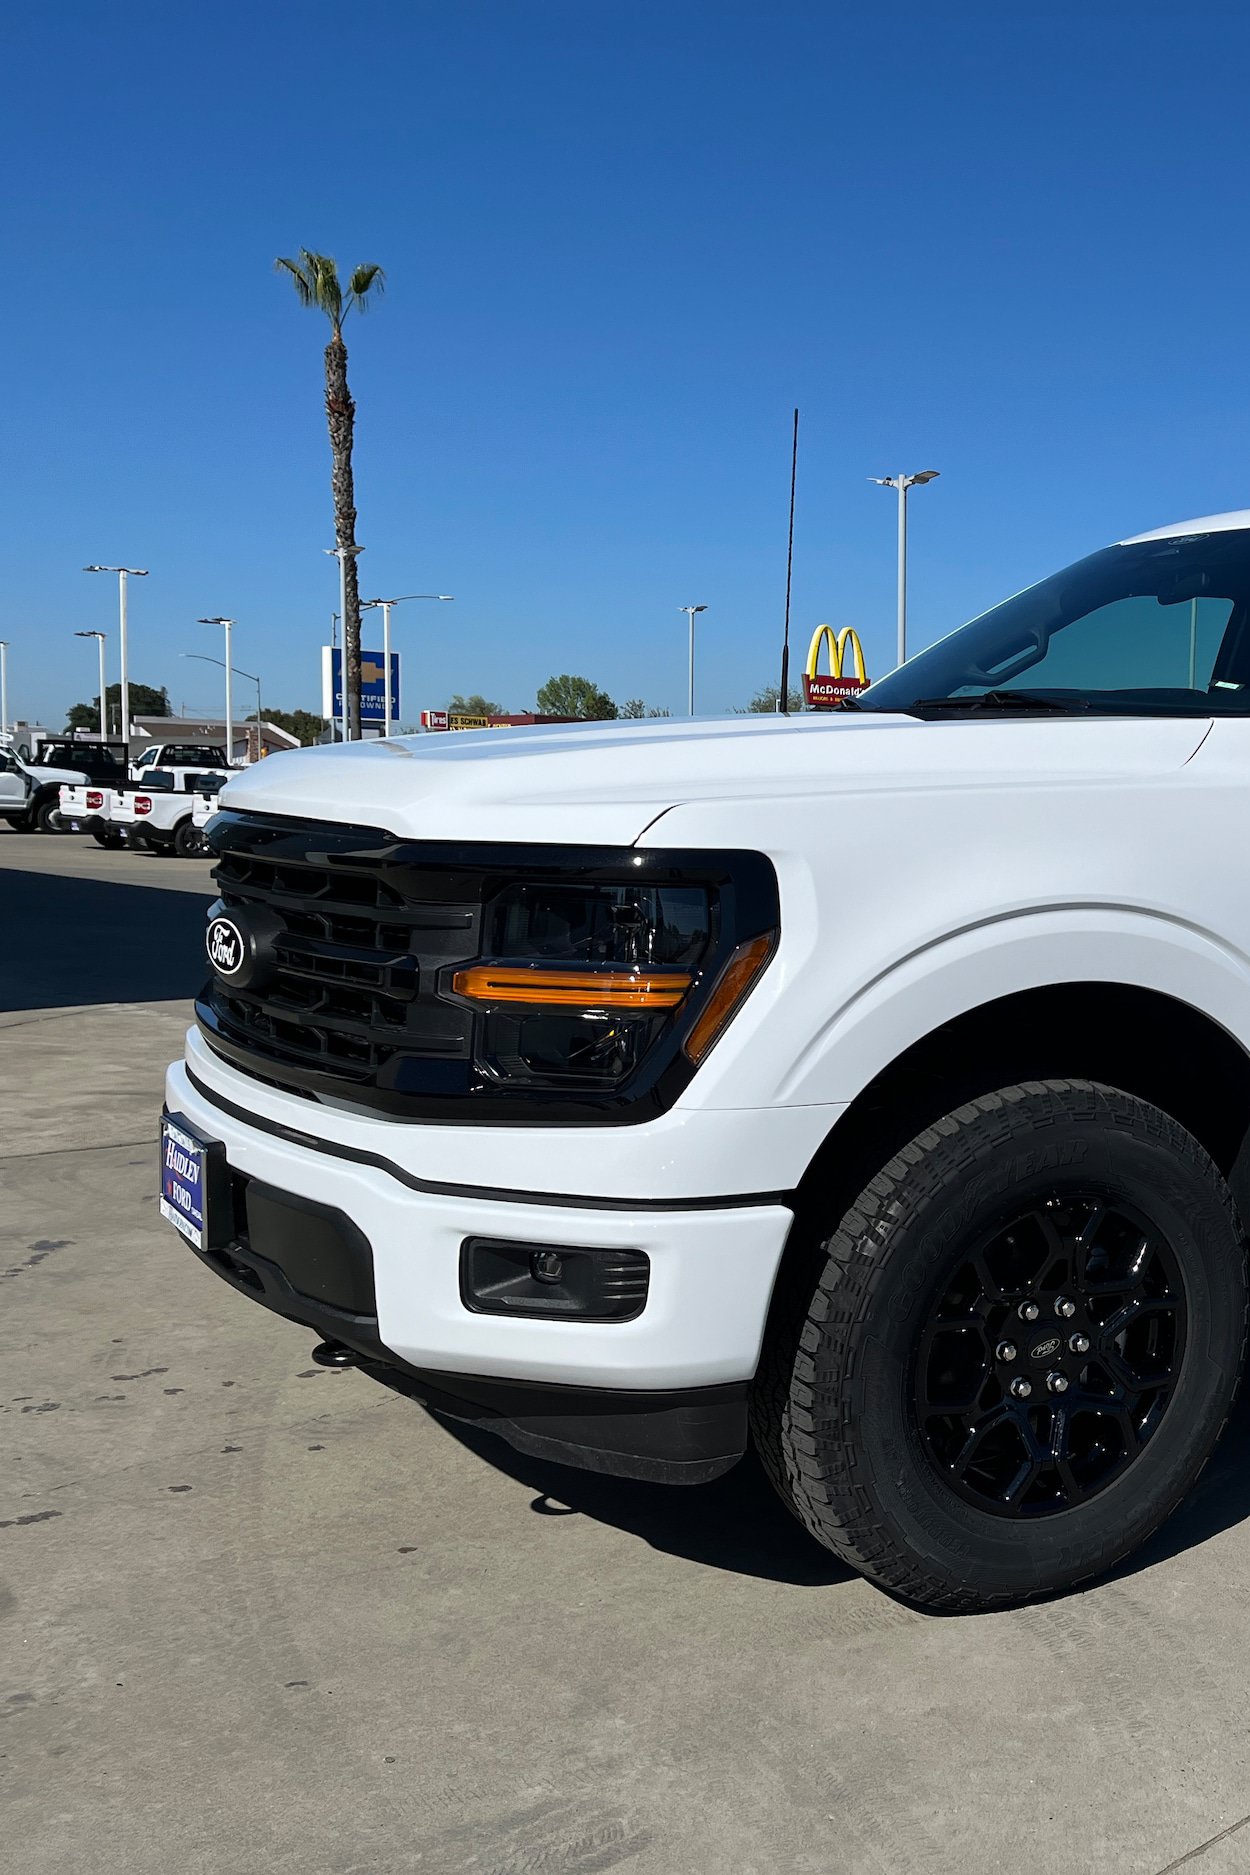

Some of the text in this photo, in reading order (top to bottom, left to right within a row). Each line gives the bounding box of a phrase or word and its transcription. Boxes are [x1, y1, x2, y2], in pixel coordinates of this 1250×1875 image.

[430, 713, 446, 726] Tires
[460, 717, 486, 726] SCHWAB
[211, 924, 236, 967] Ford
[165, 1140, 201, 1185] HAIDLEN
[172, 1180, 192, 1212] FORD
